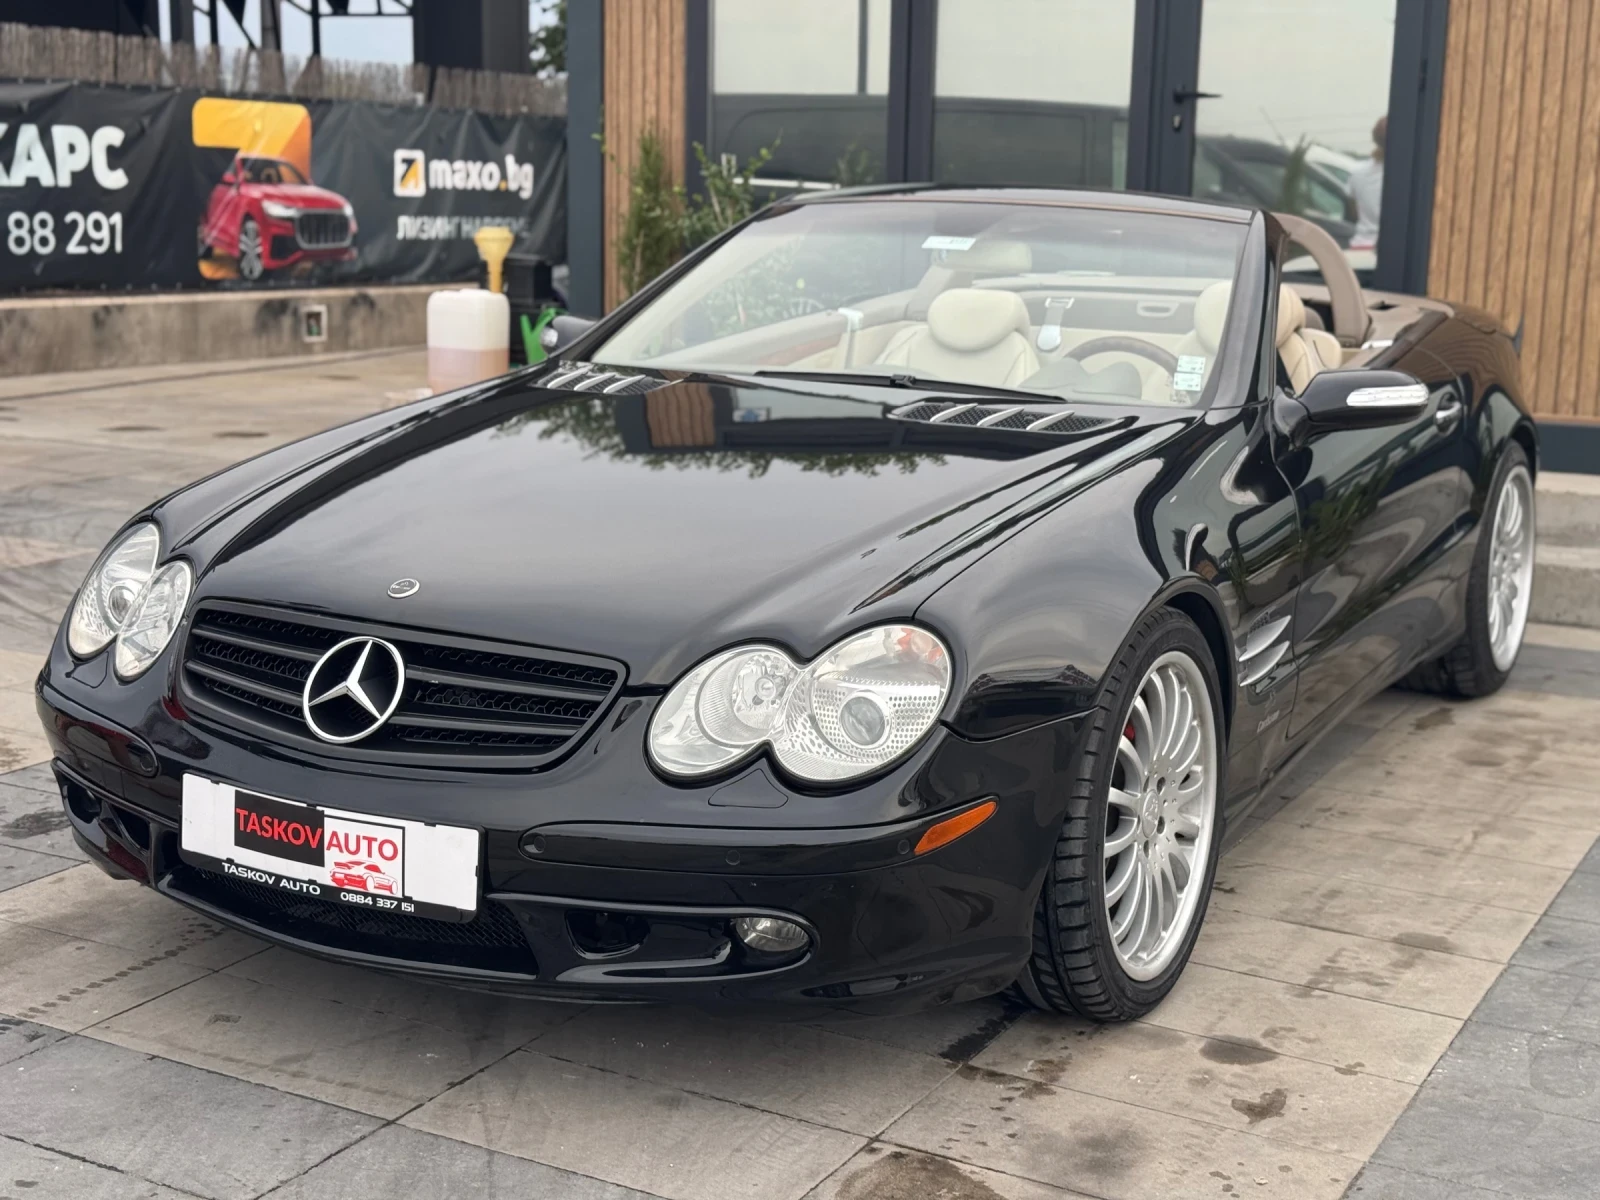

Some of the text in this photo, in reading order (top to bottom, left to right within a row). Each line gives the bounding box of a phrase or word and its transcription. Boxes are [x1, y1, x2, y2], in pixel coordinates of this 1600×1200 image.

[0, 123, 129, 190] АРС
[429, 153, 534, 199] maxo.bg
[7, 211, 123, 255] 88 291
[235, 807, 398, 861] TASKOV AUTO
[222, 862, 415, 913] TASKOV AUTO 0884 337 151
